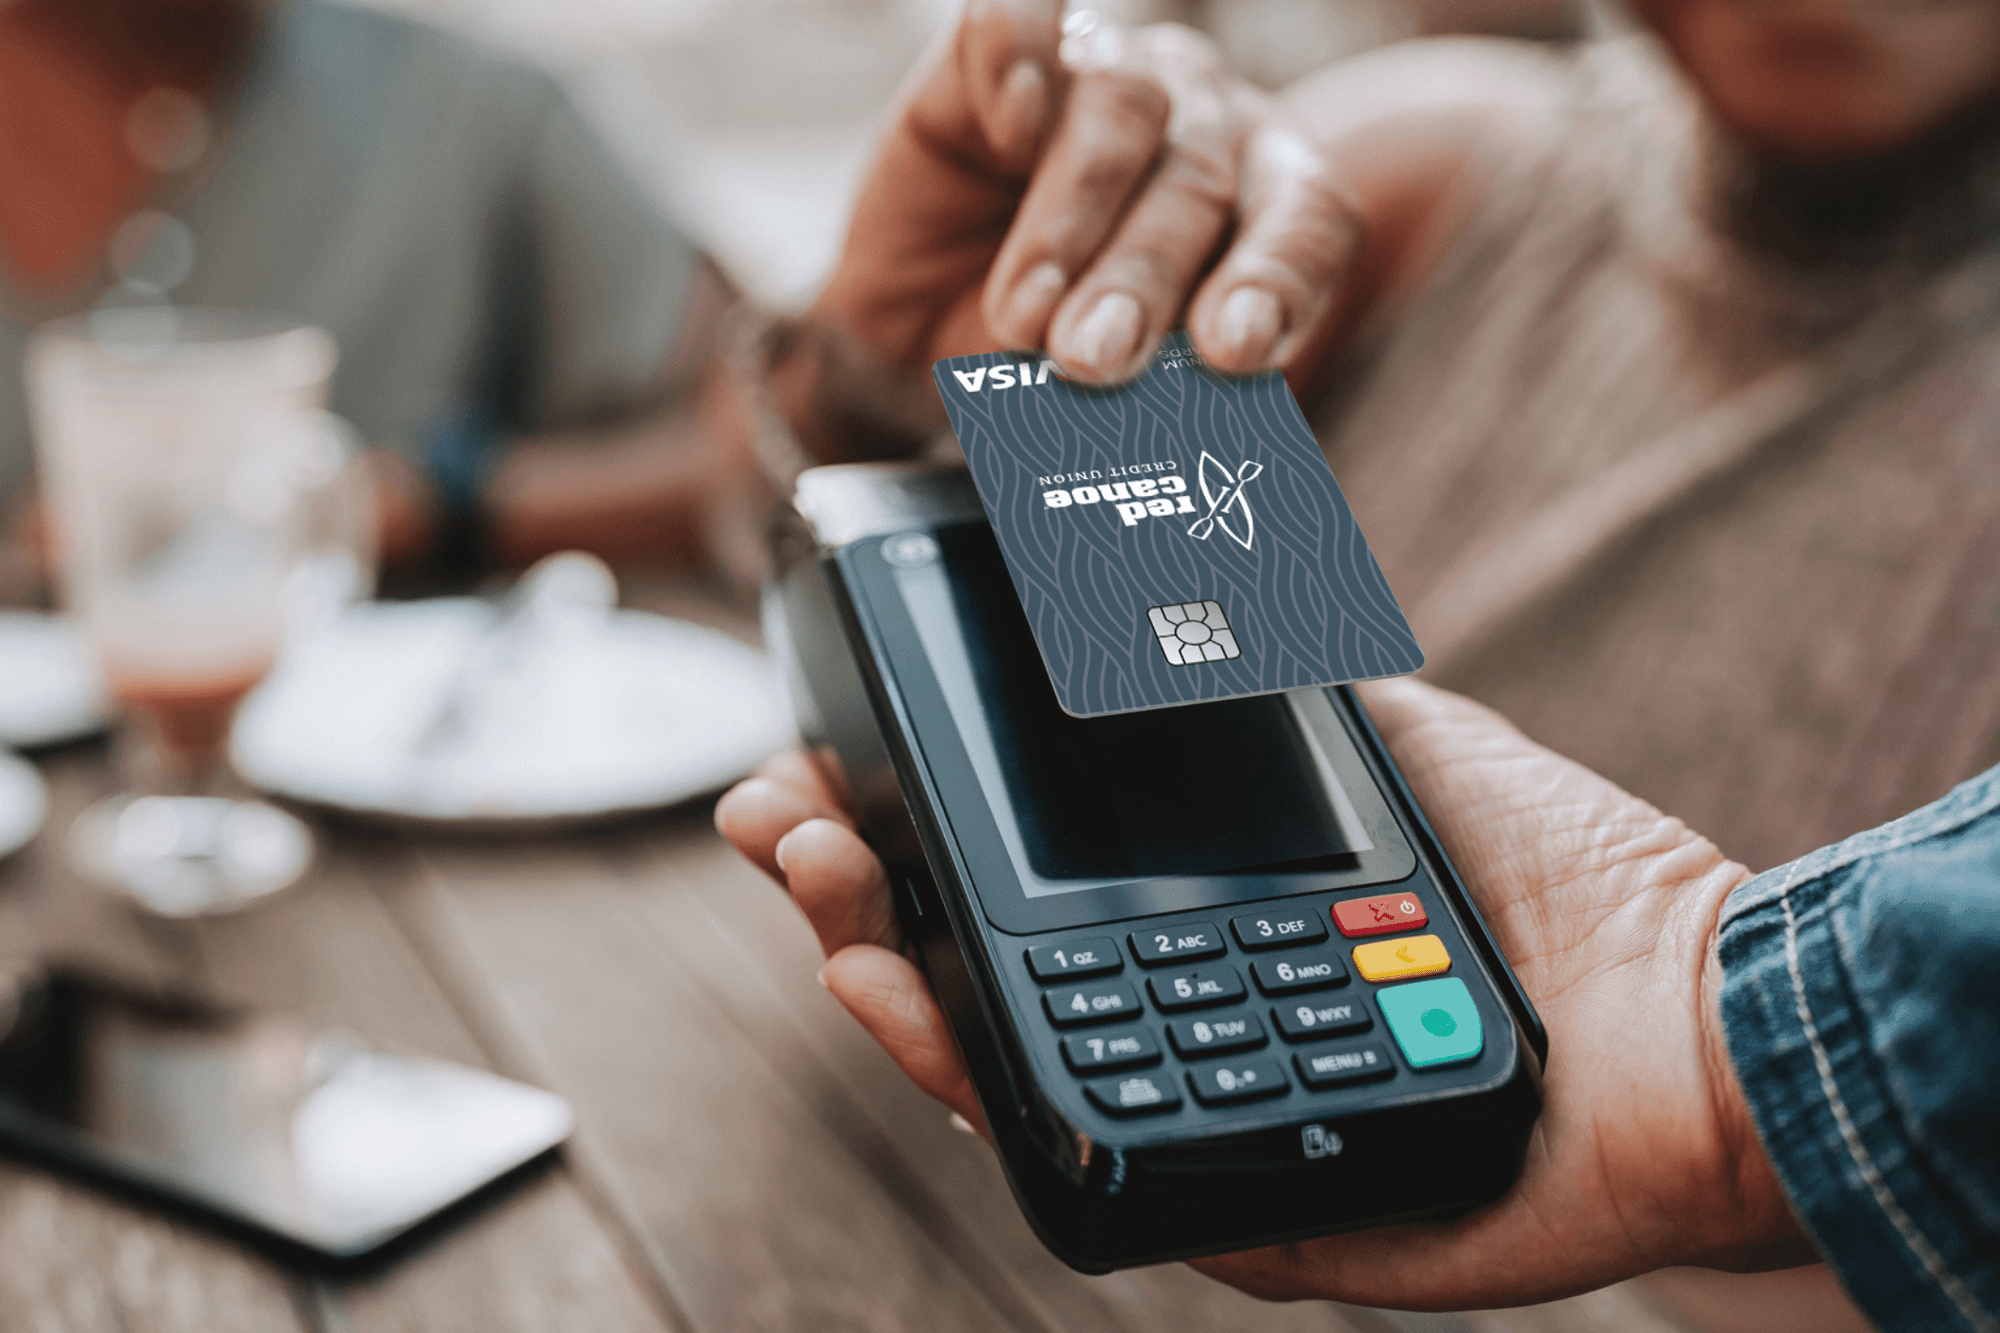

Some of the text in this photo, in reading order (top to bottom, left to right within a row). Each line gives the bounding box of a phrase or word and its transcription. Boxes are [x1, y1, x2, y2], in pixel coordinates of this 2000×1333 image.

[952, 360, 1068, 392] VISA
[1039, 460, 1177, 486] CREDIT UNION
[1043, 475, 1187, 509] canoe
[1115, 495, 1197, 527] red
[1256, 919, 1306, 936] 3 DEF
[1154, 934, 1208, 952] 2 ABC
[1053, 950, 1068, 968] 1
[1276, 962, 1332, 981] 6 MNO
[1174, 978, 1192, 998] 5
[1071, 993, 1088, 1013] 4
[1296, 1006, 1316, 1027] 9
[1193, 1020, 1246, 1043] 8 TUV
[1086, 1038, 1104, 1060] 7
[1311, 1052, 1363, 1073] MENU
